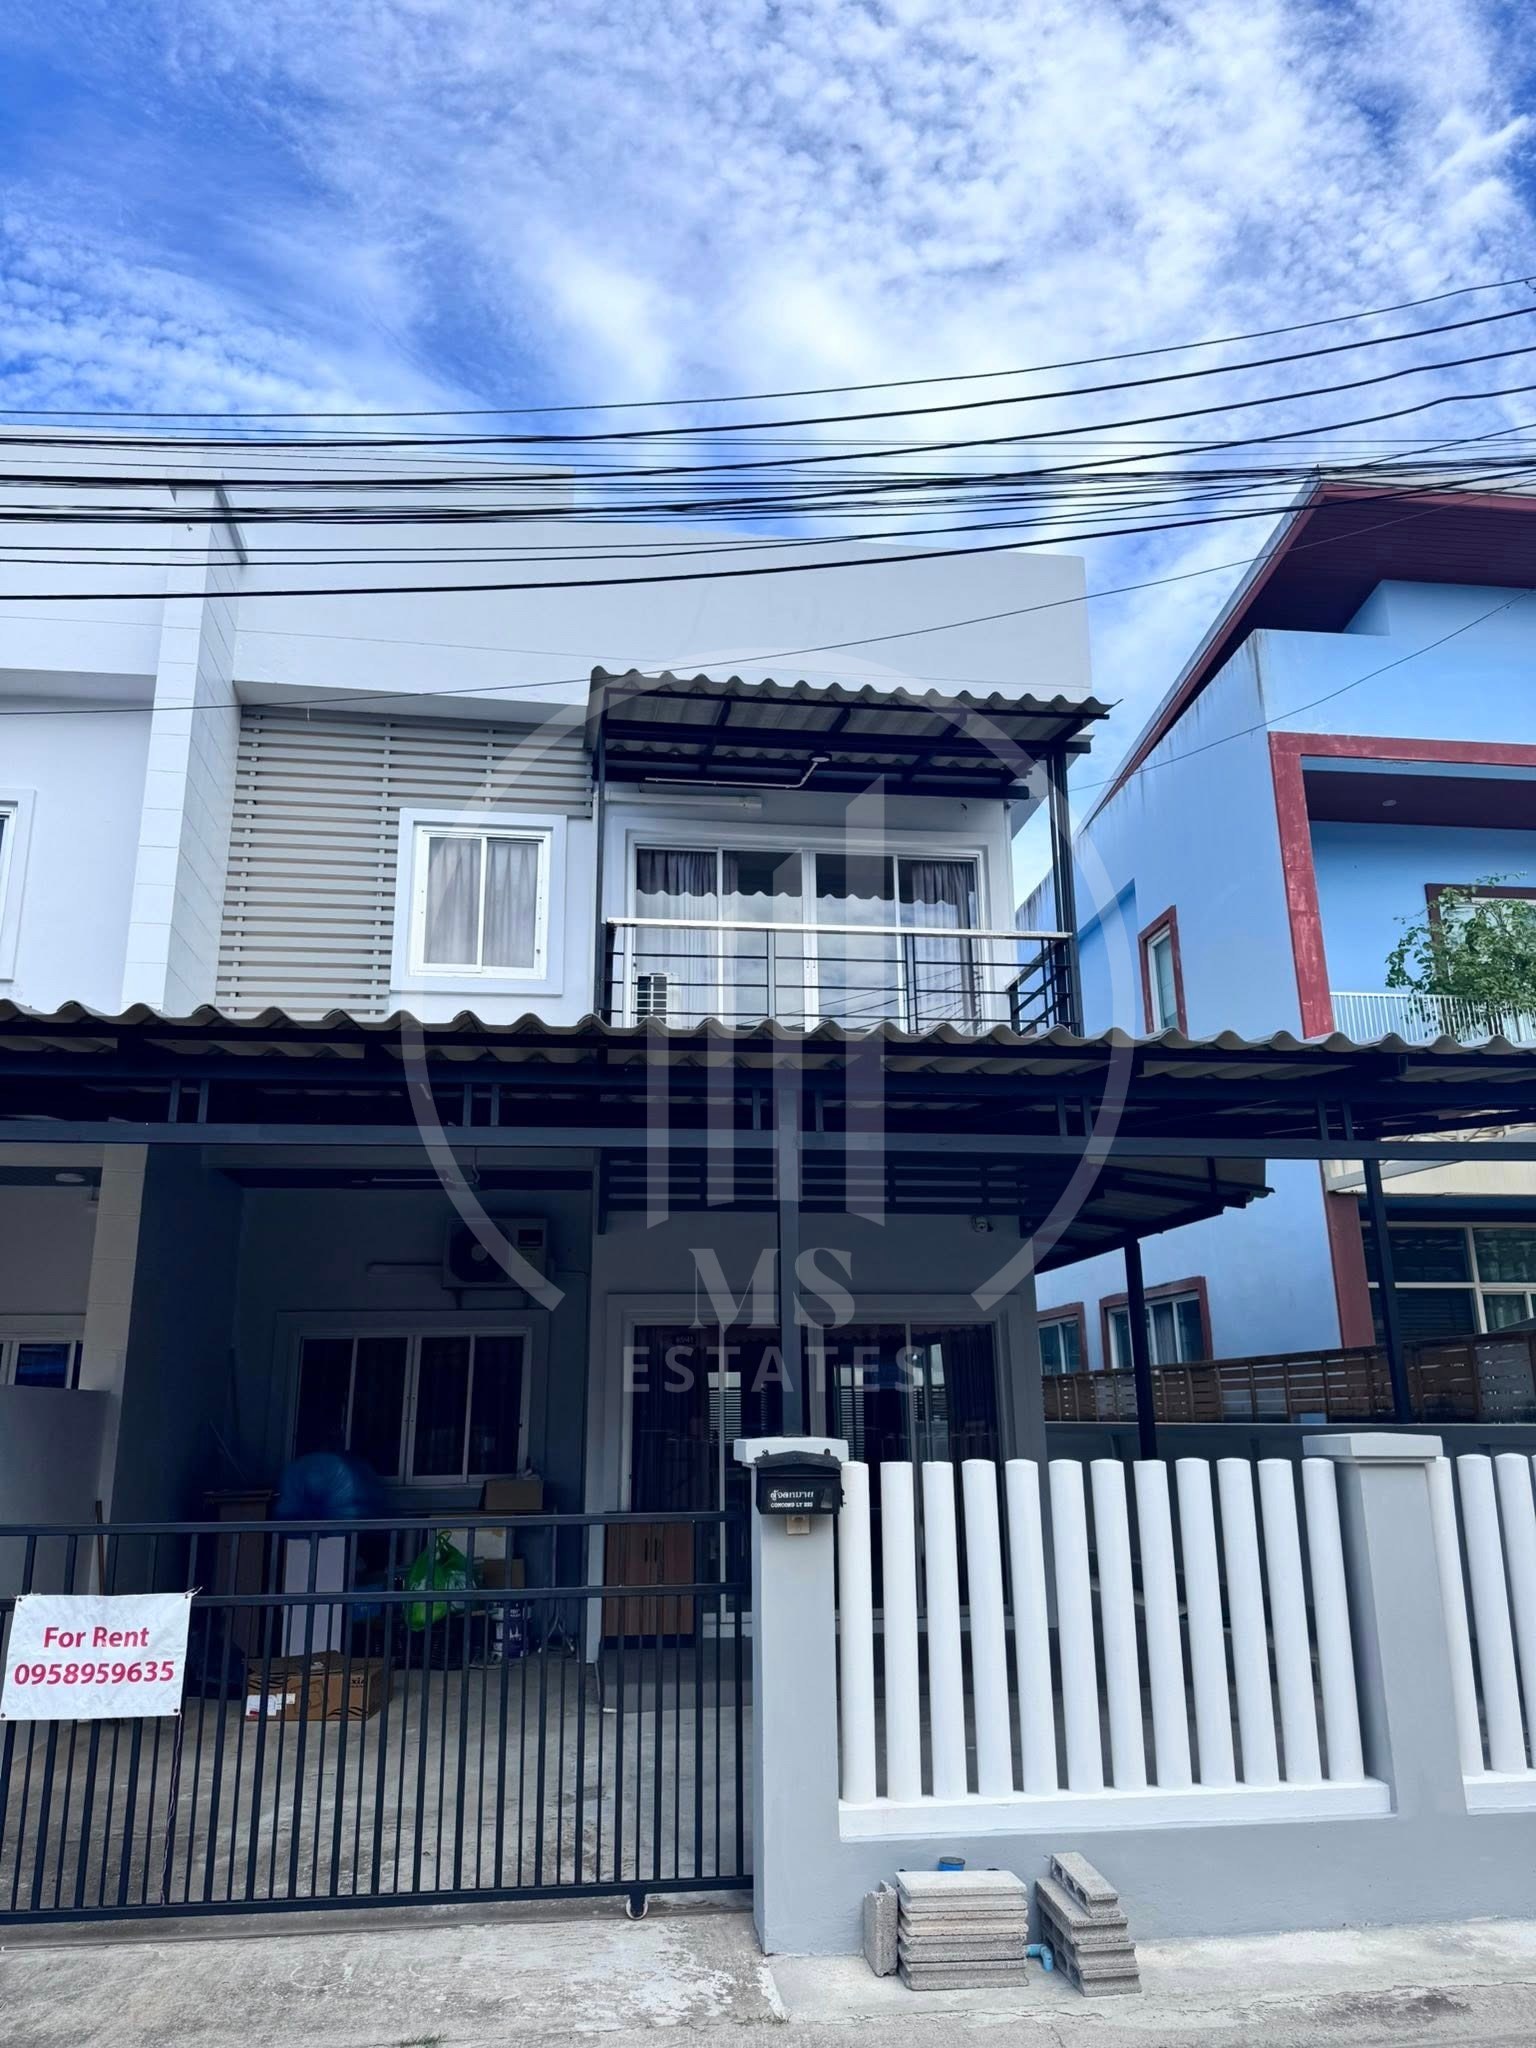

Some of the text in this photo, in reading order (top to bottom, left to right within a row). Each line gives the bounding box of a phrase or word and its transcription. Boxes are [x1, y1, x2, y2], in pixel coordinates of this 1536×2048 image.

[43, 1626, 150, 1648] For Rent
[14, 1661, 175, 1685] 0958959635
